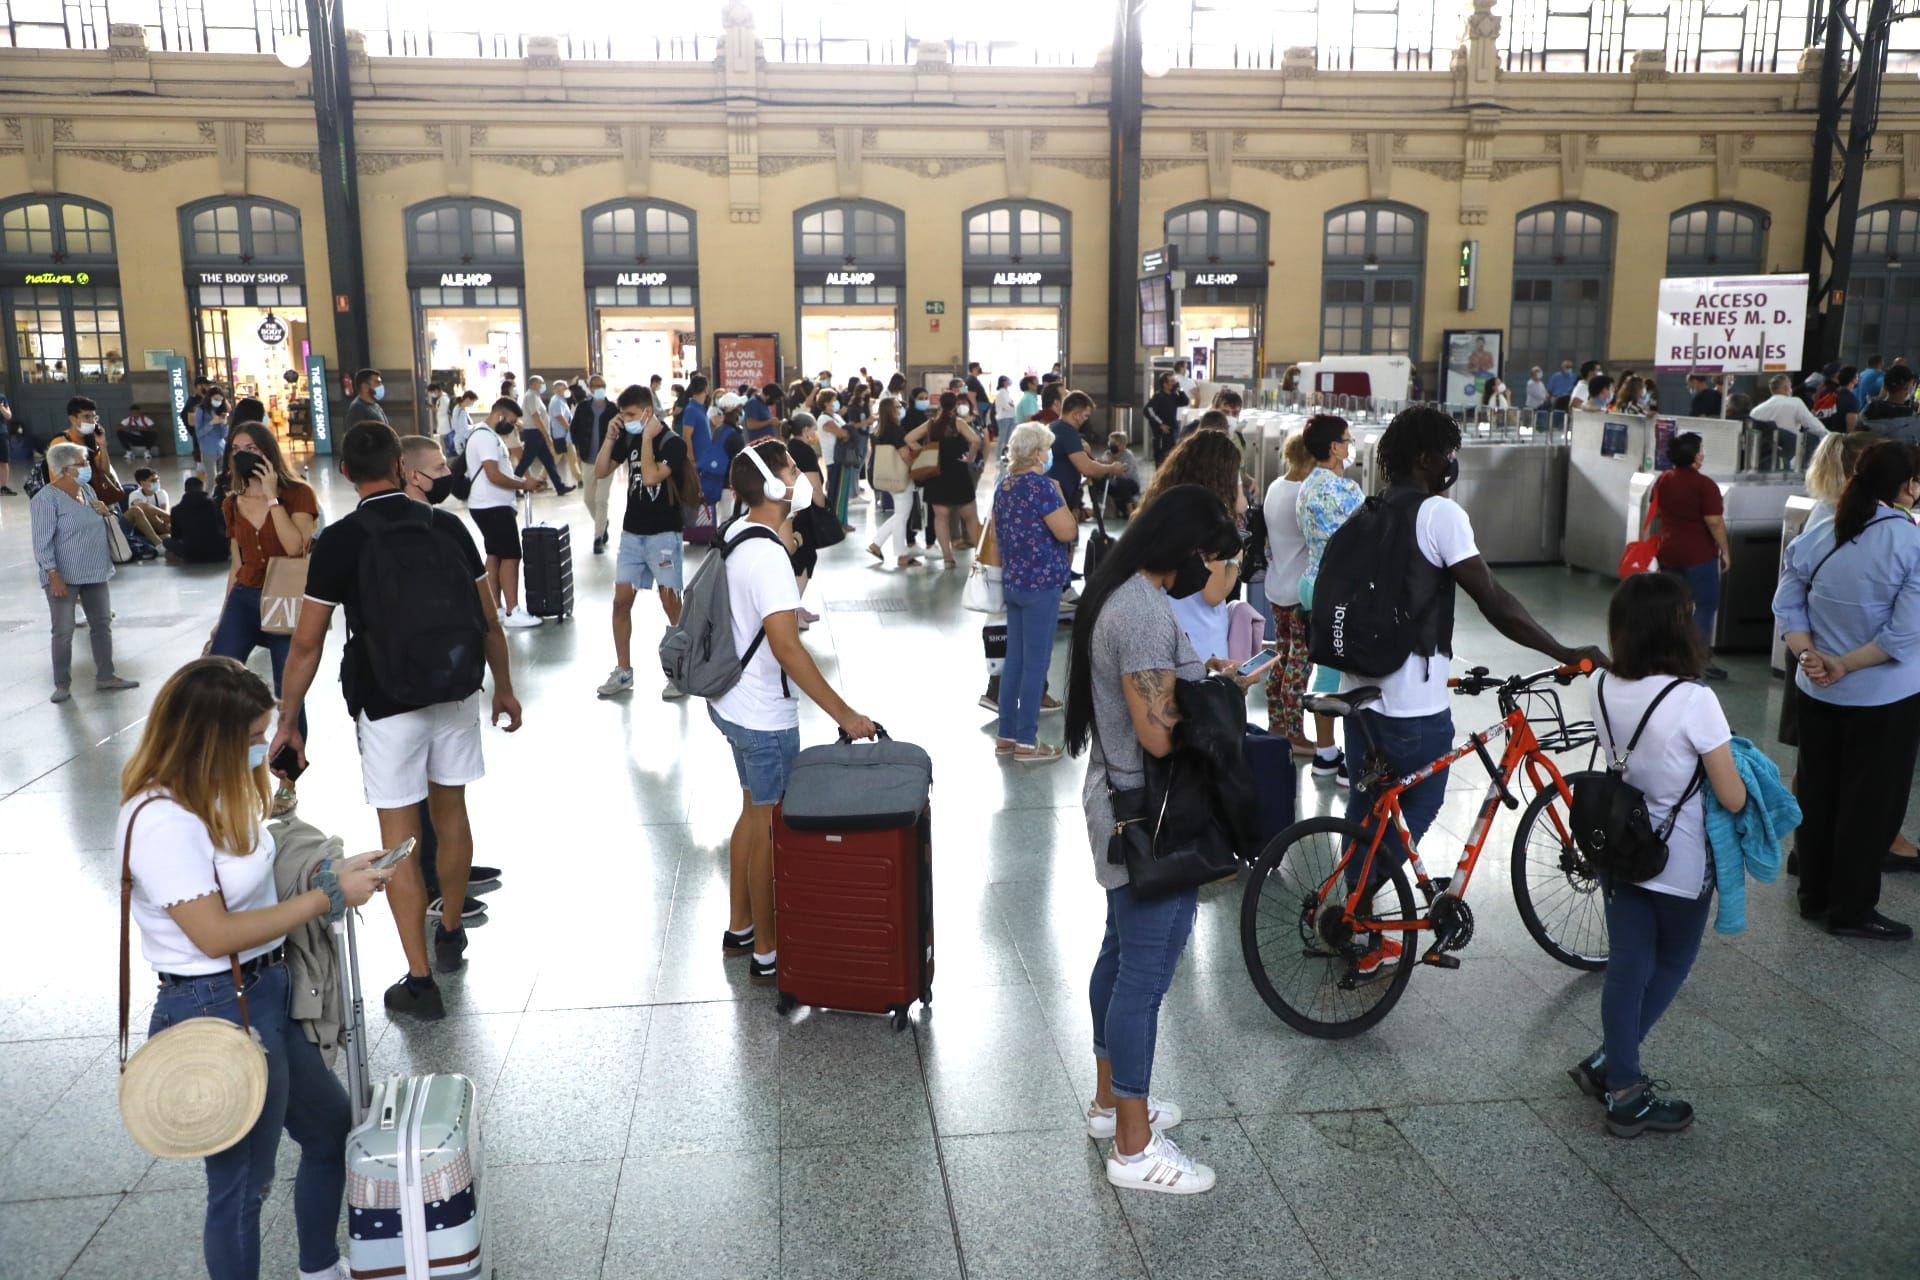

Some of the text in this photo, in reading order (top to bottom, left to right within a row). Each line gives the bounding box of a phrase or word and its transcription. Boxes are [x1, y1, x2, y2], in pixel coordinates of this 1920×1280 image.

[25, 272, 75, 284] natura
[199, 273, 289, 284] THE BODY SHOP
[440, 273, 492, 287] ALE-HOP
[616, 272, 667, 286] ALE-HOP
[826, 272, 876, 285] ALE-HOP
[993, 272, 1042, 285] ALE-HOP
[1195, 273, 1239, 285] ALE-HOP
[1695, 293, 1768, 308] ACCESO
[1669, 310, 1792, 326] TRENES M. D.
[1724, 328, 1736, 342] Y
[736, 351, 756, 360] QUE
[1671, 344, 1787, 360] REGIONALES
[724, 360, 764, 369] NO POTS
[172, 367, 183, 387] THE
[311, 366, 326, 440] THE BODY SHOP
